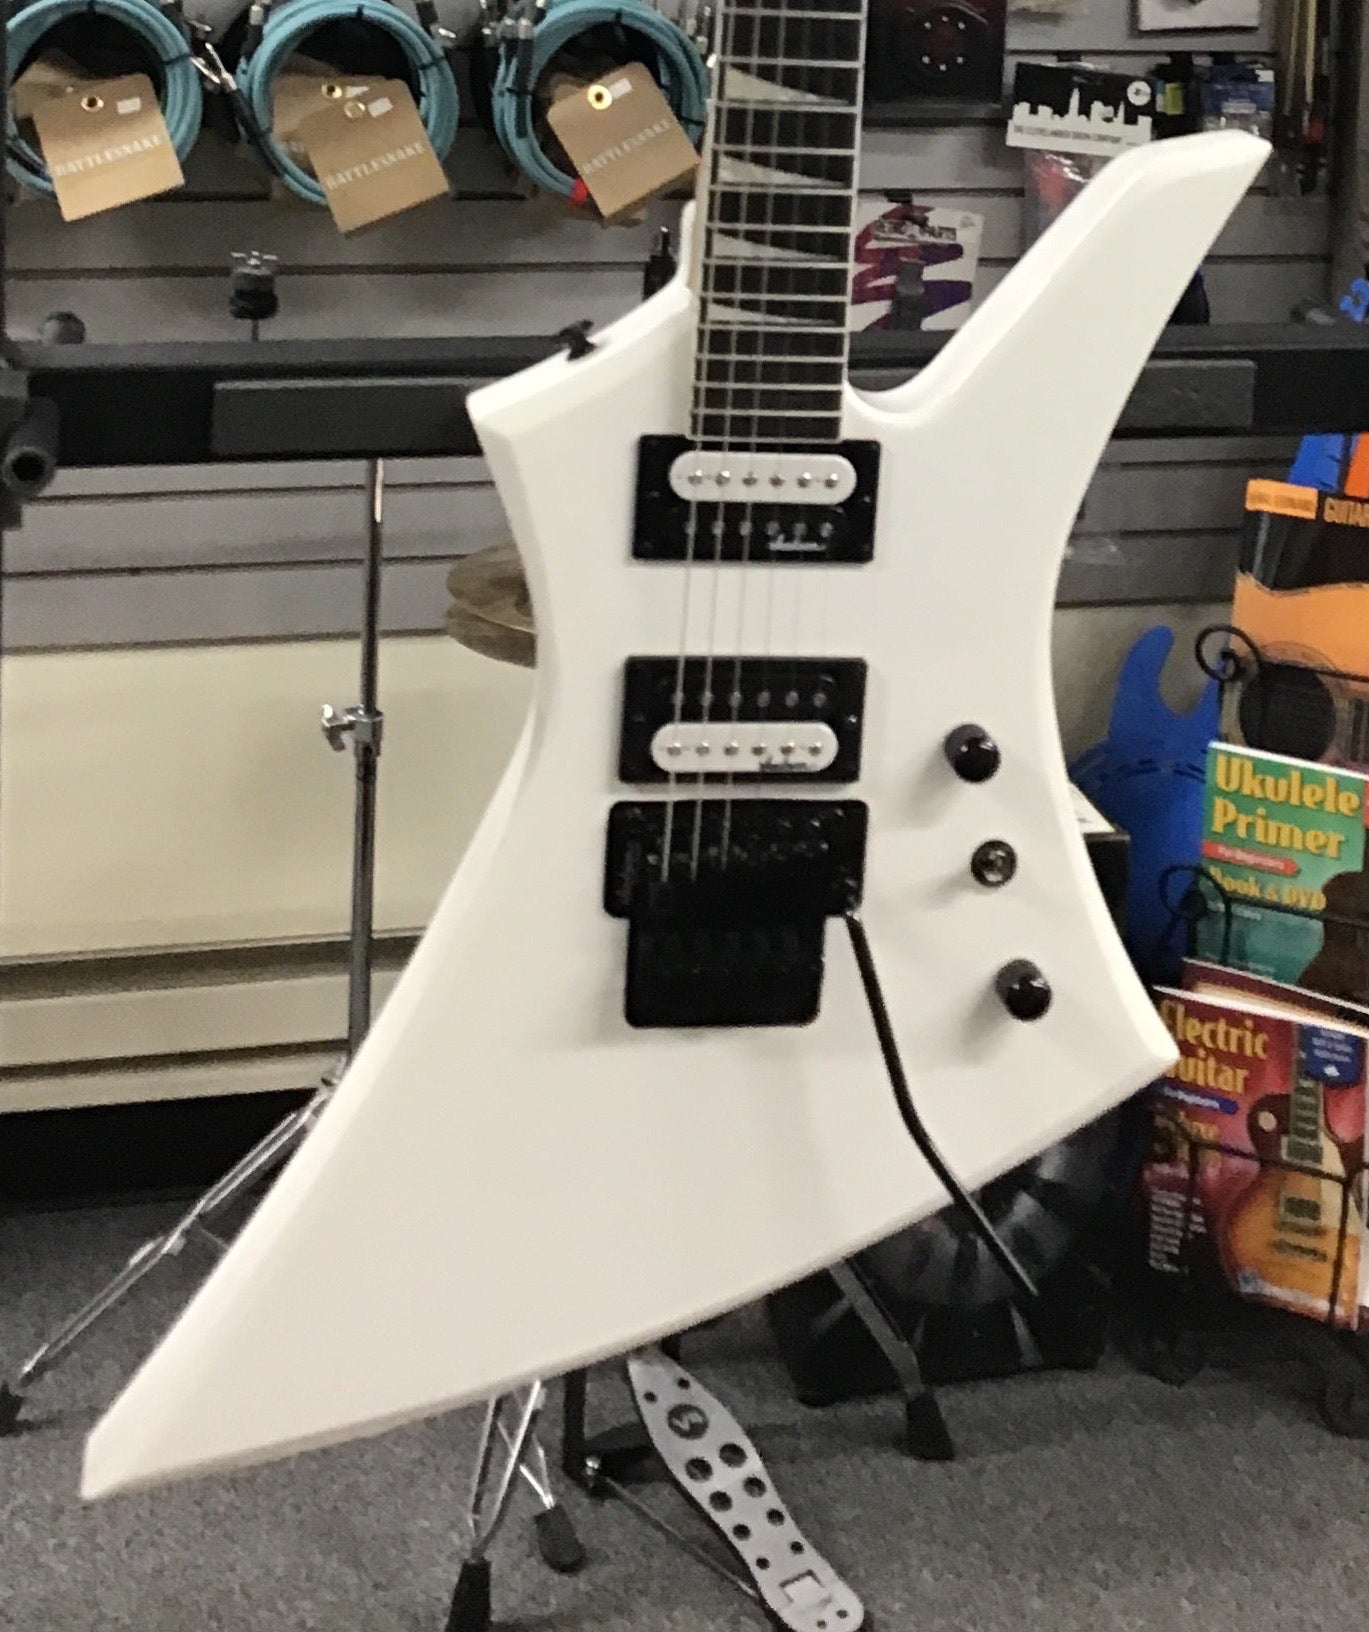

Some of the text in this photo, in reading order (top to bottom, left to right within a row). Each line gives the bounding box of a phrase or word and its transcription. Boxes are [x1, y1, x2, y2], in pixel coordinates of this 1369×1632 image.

[54, 134, 162, 177] RATTLESNAKE
[1215, 752, 1361, 817] Ukulele
[1211, 796, 1346, 859] Primer
